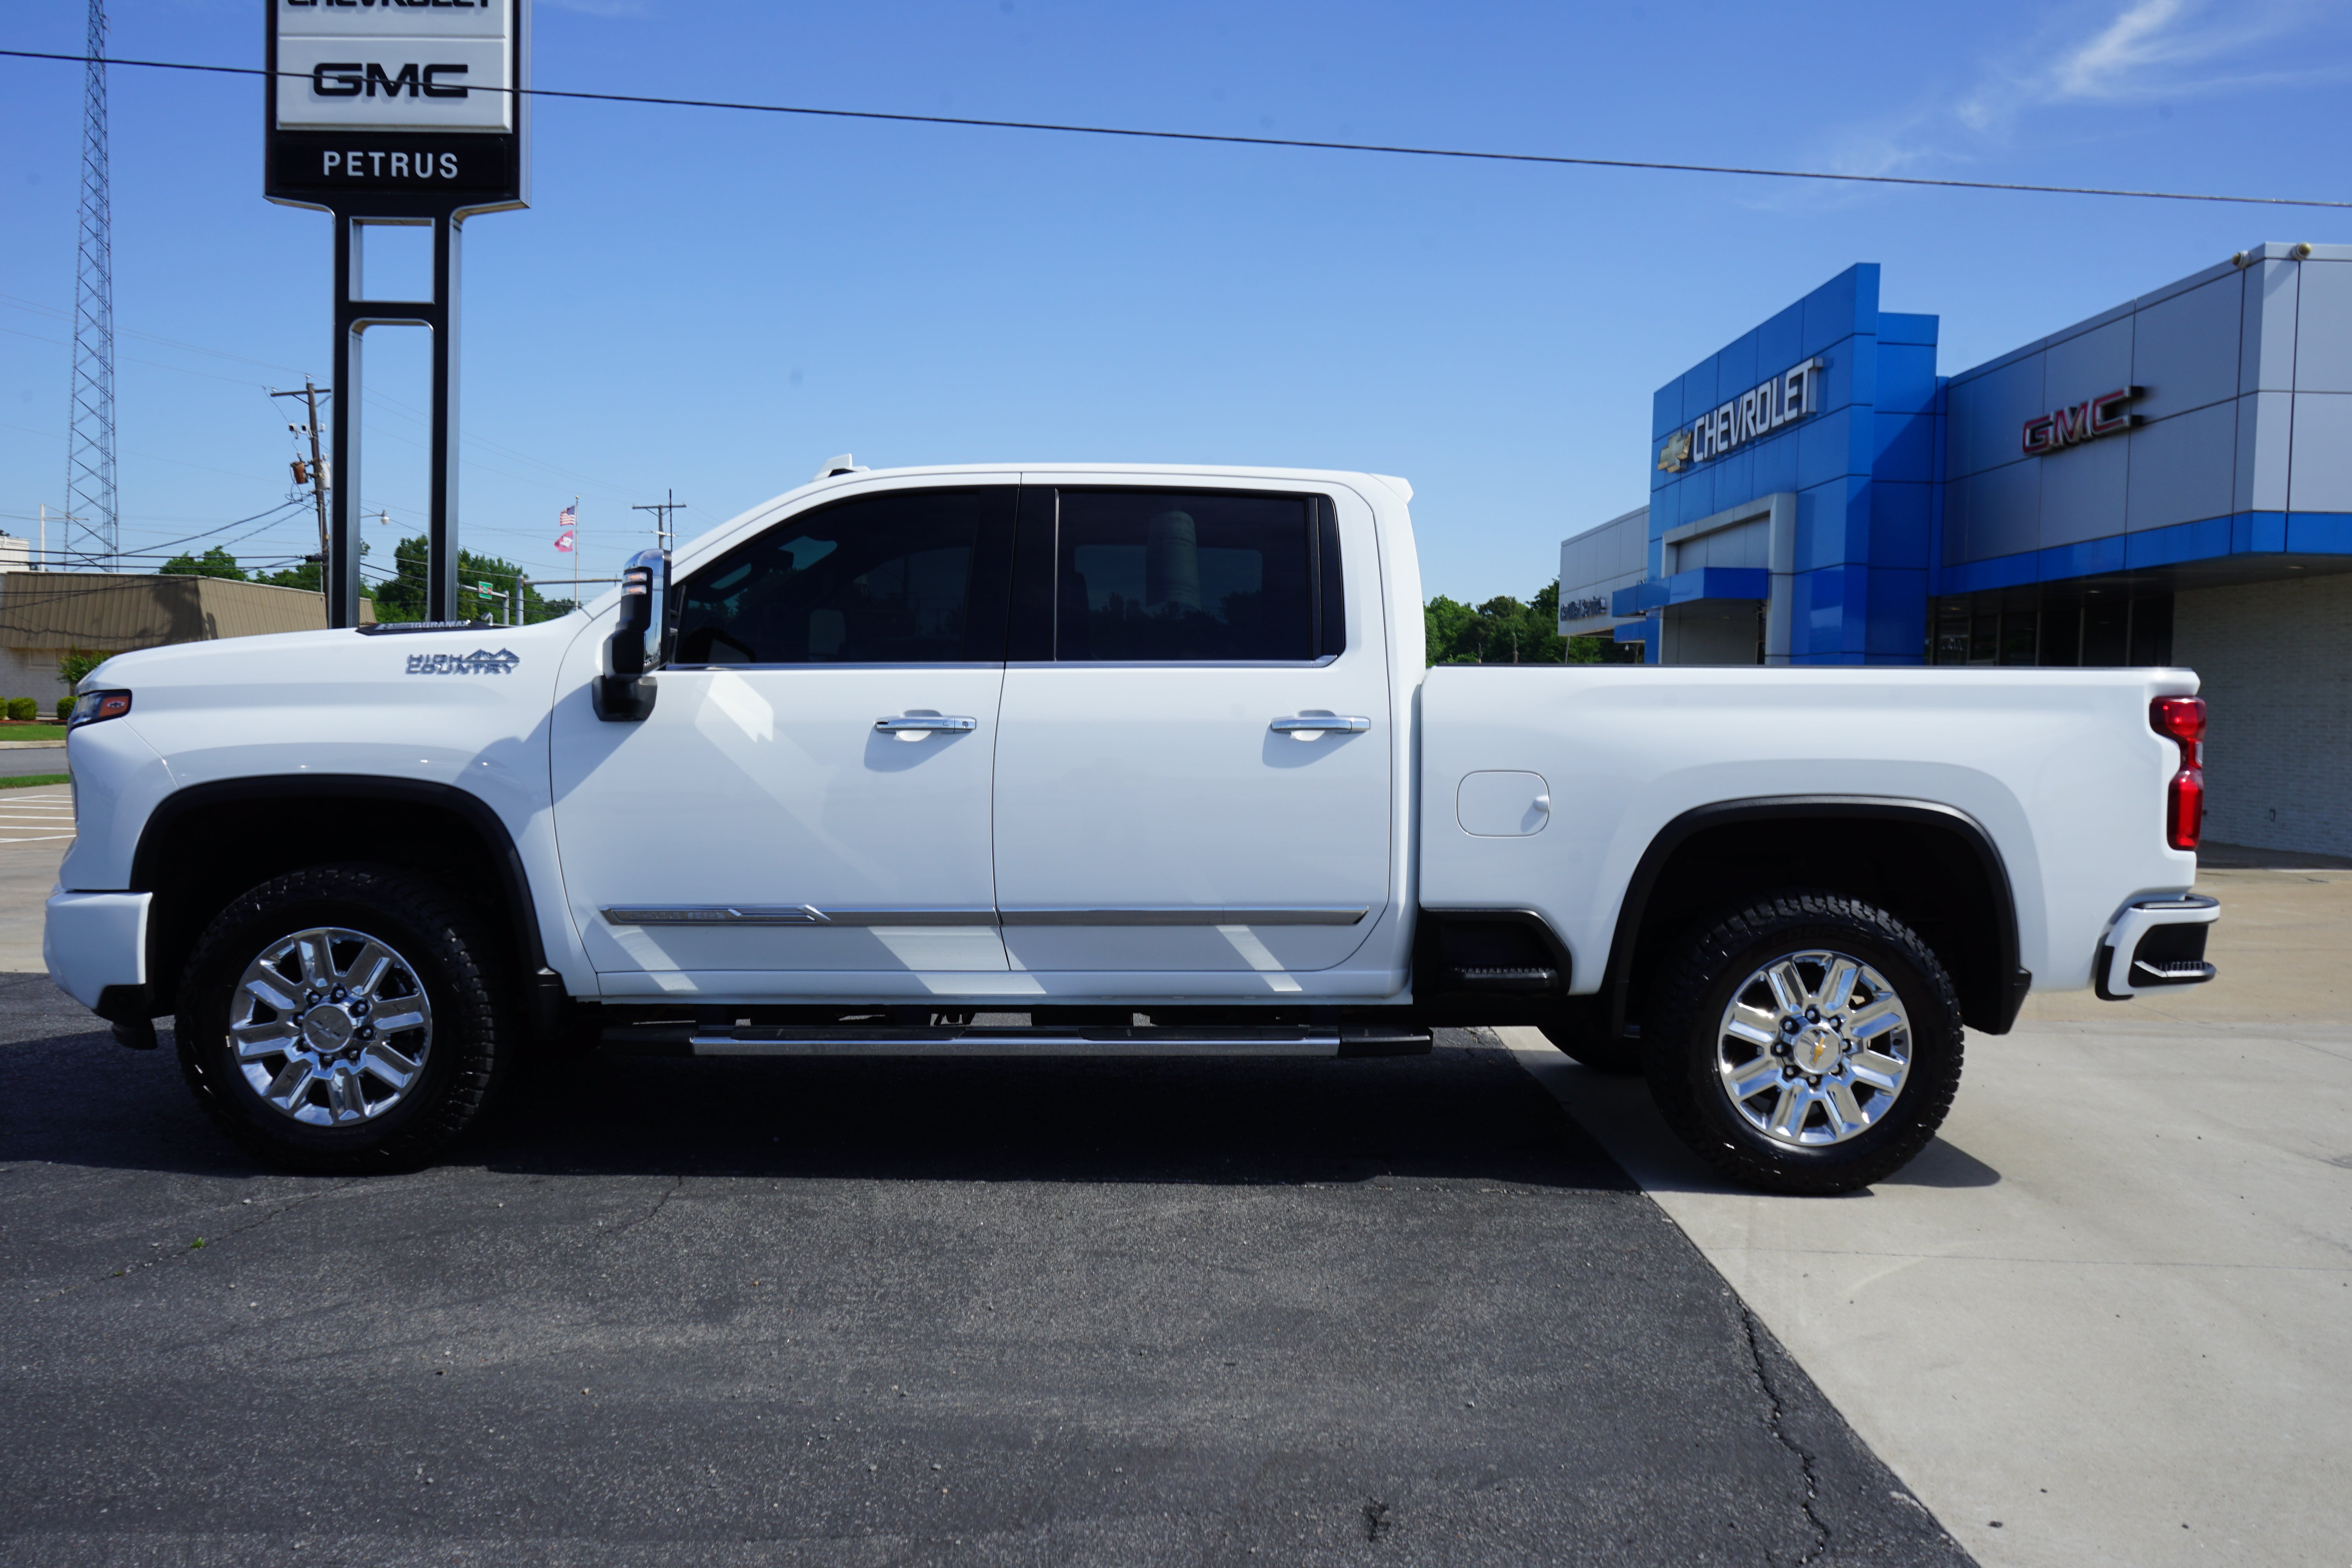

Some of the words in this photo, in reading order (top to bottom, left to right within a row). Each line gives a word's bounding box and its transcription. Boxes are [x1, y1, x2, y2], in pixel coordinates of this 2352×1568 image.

[313, 63, 468, 98] GMC
[323, 151, 458, 179] PETRUS
[1693, 357, 1824, 463] CHEVROLET
[2021, 386, 2143, 456] GMC
[405, 663, 514, 675] COUNTRY
[1771, 925, 1871, 947] COOPER
